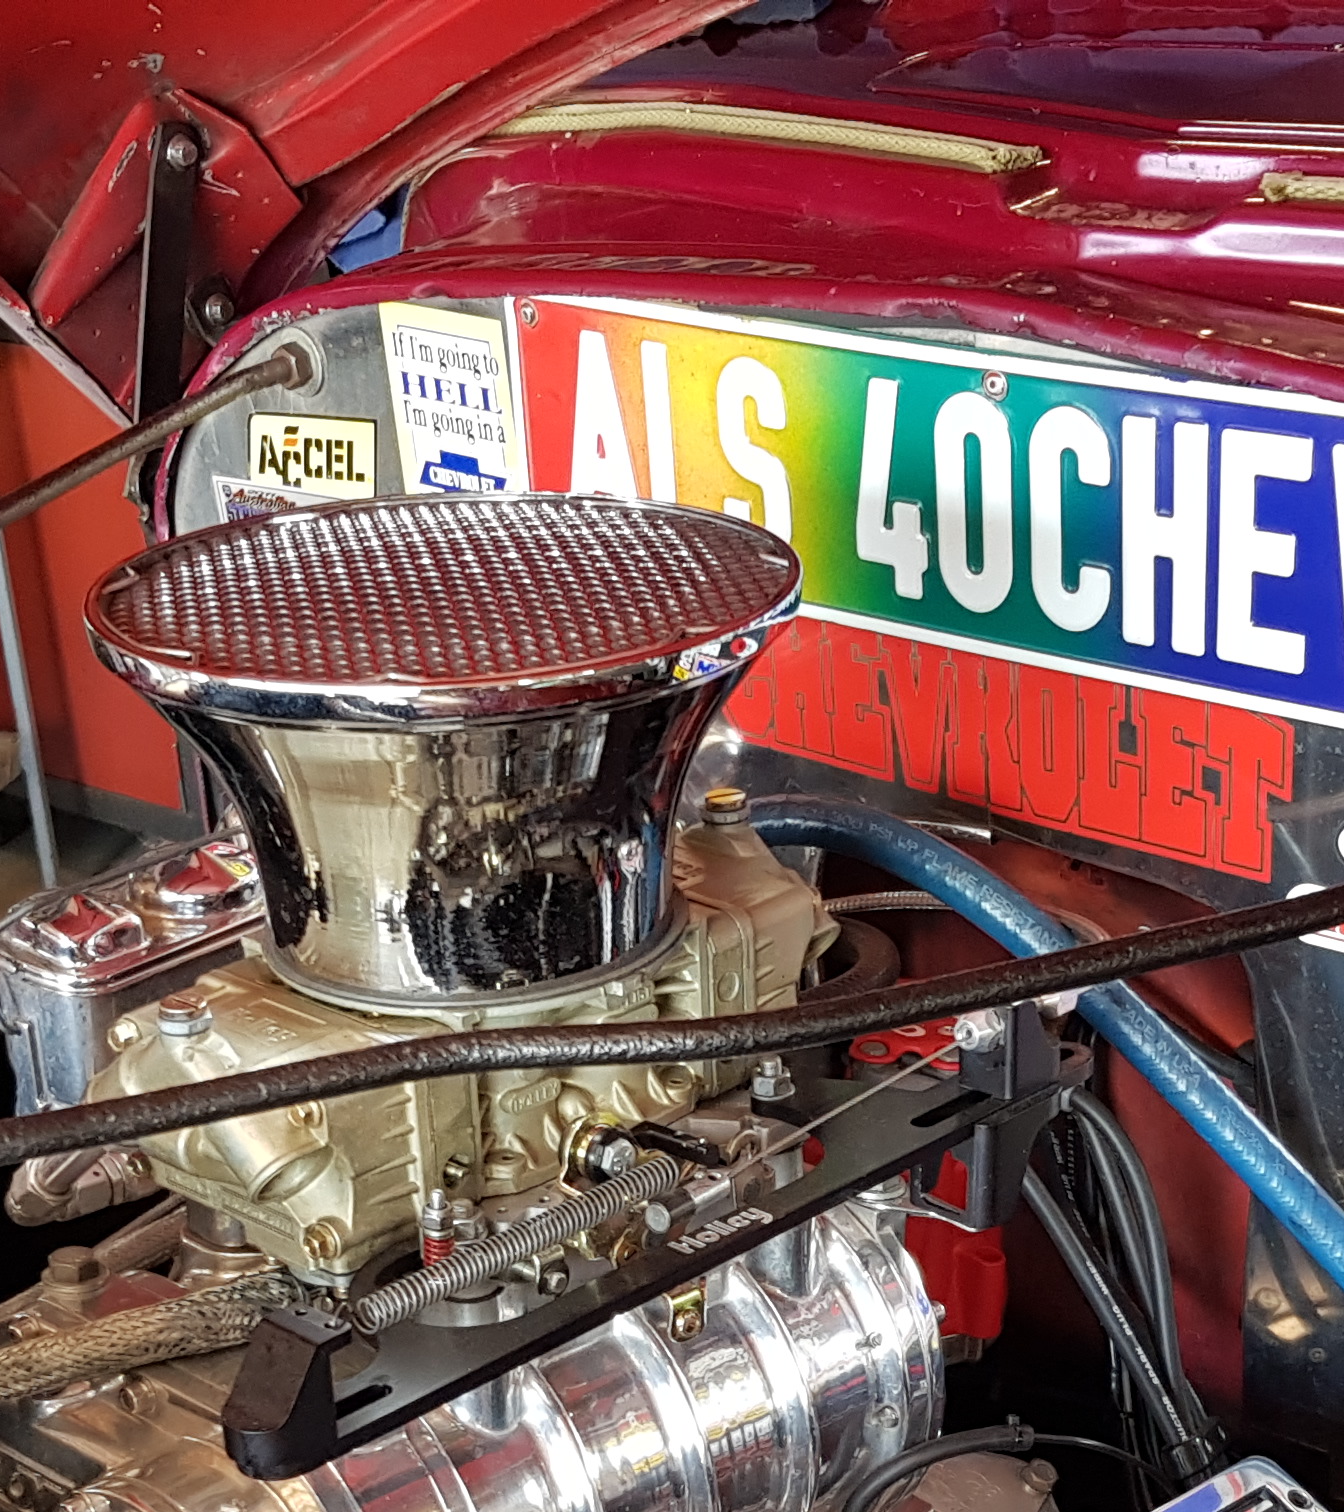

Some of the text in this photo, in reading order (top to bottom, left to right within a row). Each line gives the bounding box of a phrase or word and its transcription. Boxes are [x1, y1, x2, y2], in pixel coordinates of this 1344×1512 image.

[392, 331, 500, 381] If I'm going to
[400, 370, 503, 415] HELL
[403, 399, 507, 446] I'm going in a
[258, 434, 366, 489] ACCEL
[922, 848, 979, 891] FLAME
[666, 1205, 775, 1256] Holley
[1111, 1304, 1135, 1337] PLUG
[1135, 1345, 1161, 1386] SPARK
